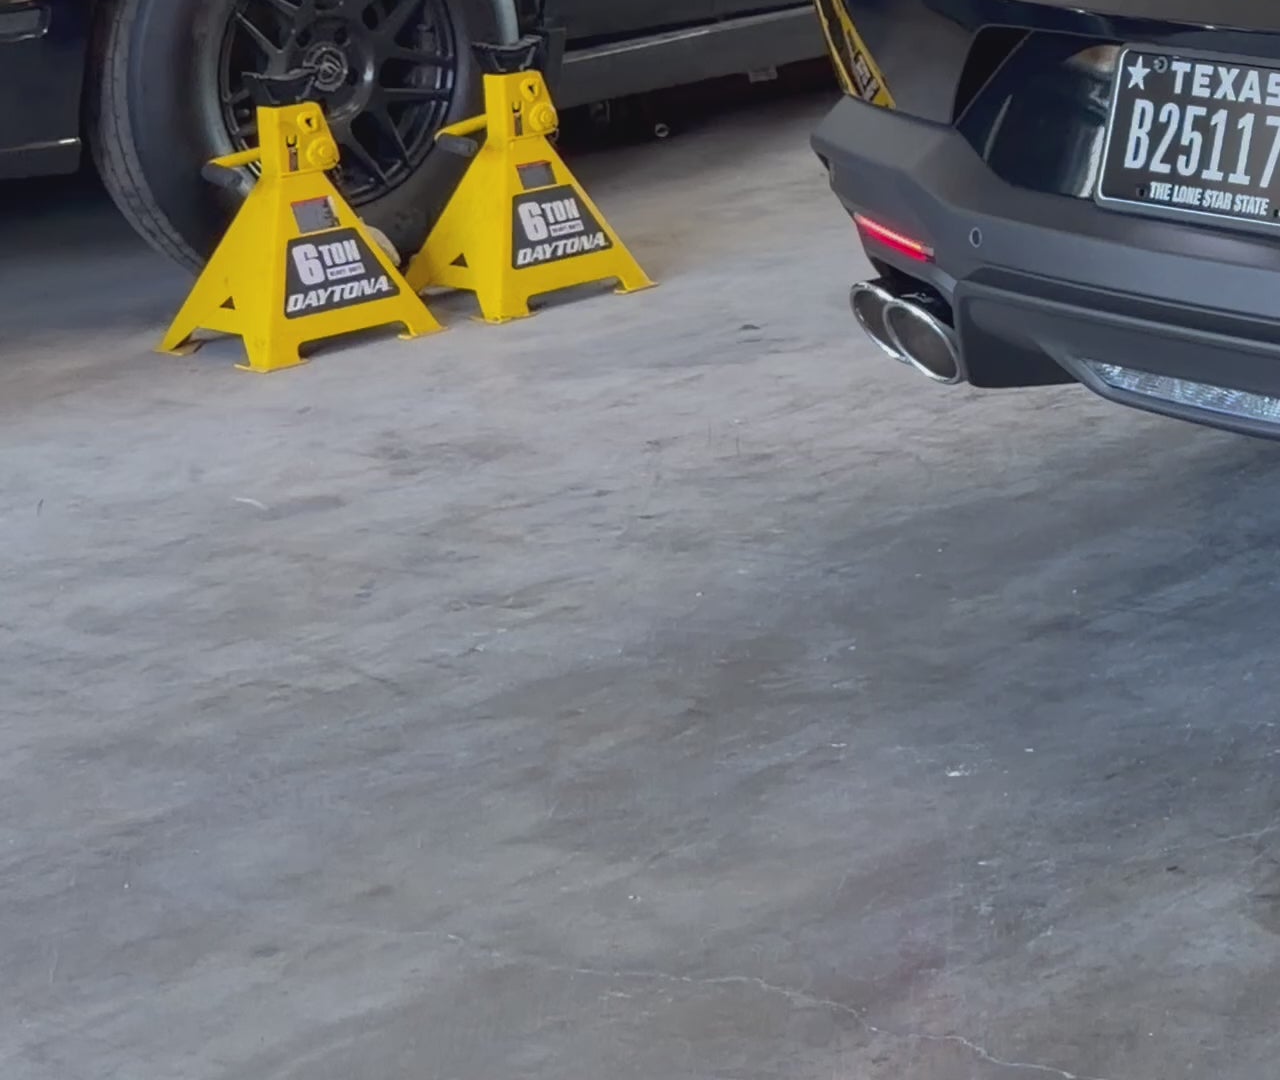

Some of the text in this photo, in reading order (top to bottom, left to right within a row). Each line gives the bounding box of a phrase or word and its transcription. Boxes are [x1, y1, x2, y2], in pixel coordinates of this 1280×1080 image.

[1150, 181, 1270, 215] THE LONE STAR STATE
[517, 201, 549, 241] 6
[541, 197, 580, 224] TON
[291, 243, 326, 286] 6
[318, 239, 361, 266] TON
[516, 231, 606, 266] DAYTONA
[286, 275, 389, 313] DAYTONA
